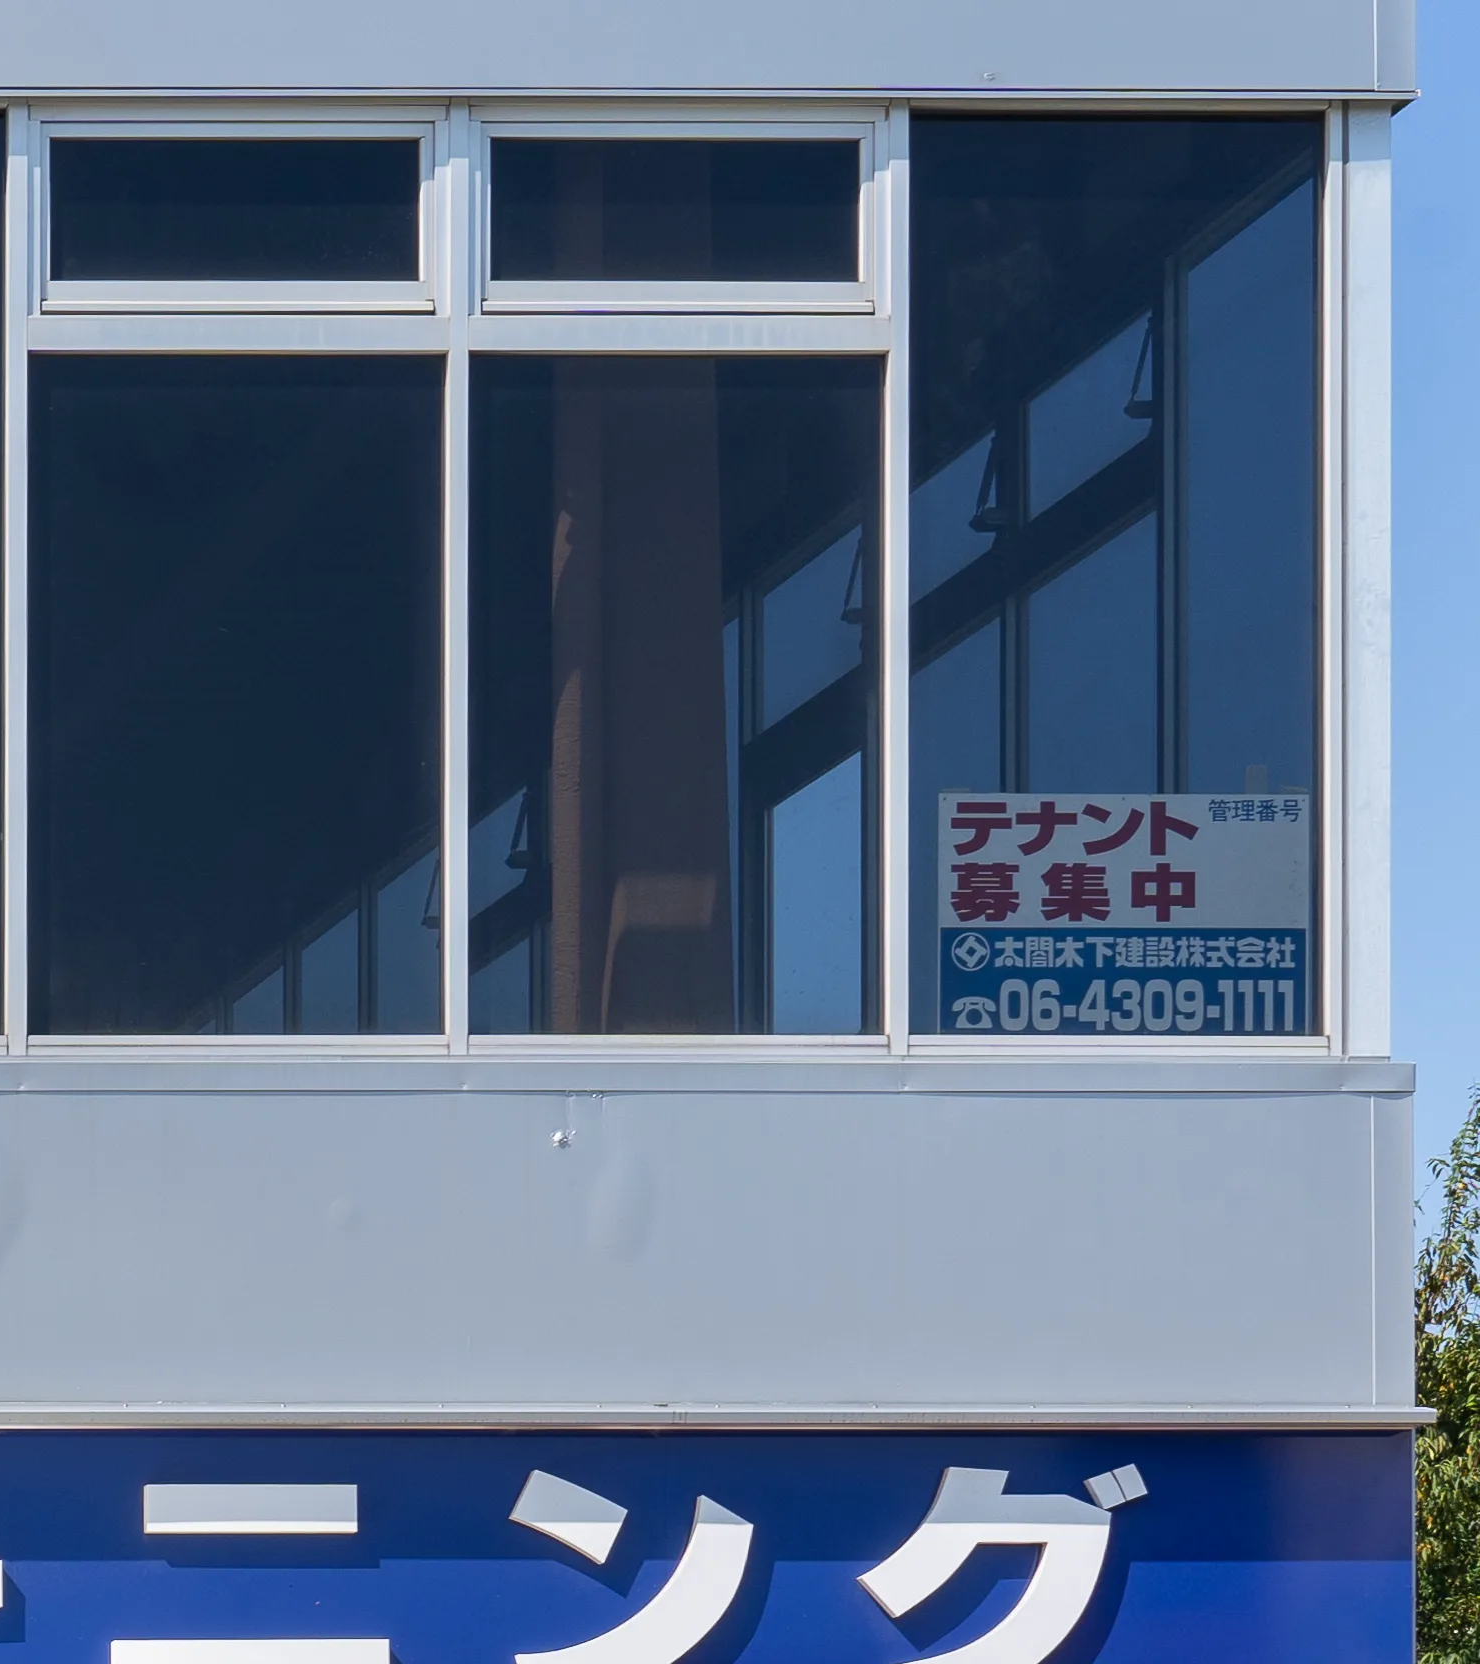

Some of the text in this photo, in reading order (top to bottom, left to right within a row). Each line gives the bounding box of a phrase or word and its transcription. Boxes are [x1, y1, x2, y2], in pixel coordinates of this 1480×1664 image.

[950, 801, 1199, 856] テナント
[1207, 799, 1302, 822] 管理番号
[950, 862, 1196, 922] 募集中
[994, 936, 1296, 968] 太閤木下建設株式会社
[999, 978, 1295, 1032] 06-4309-1111
